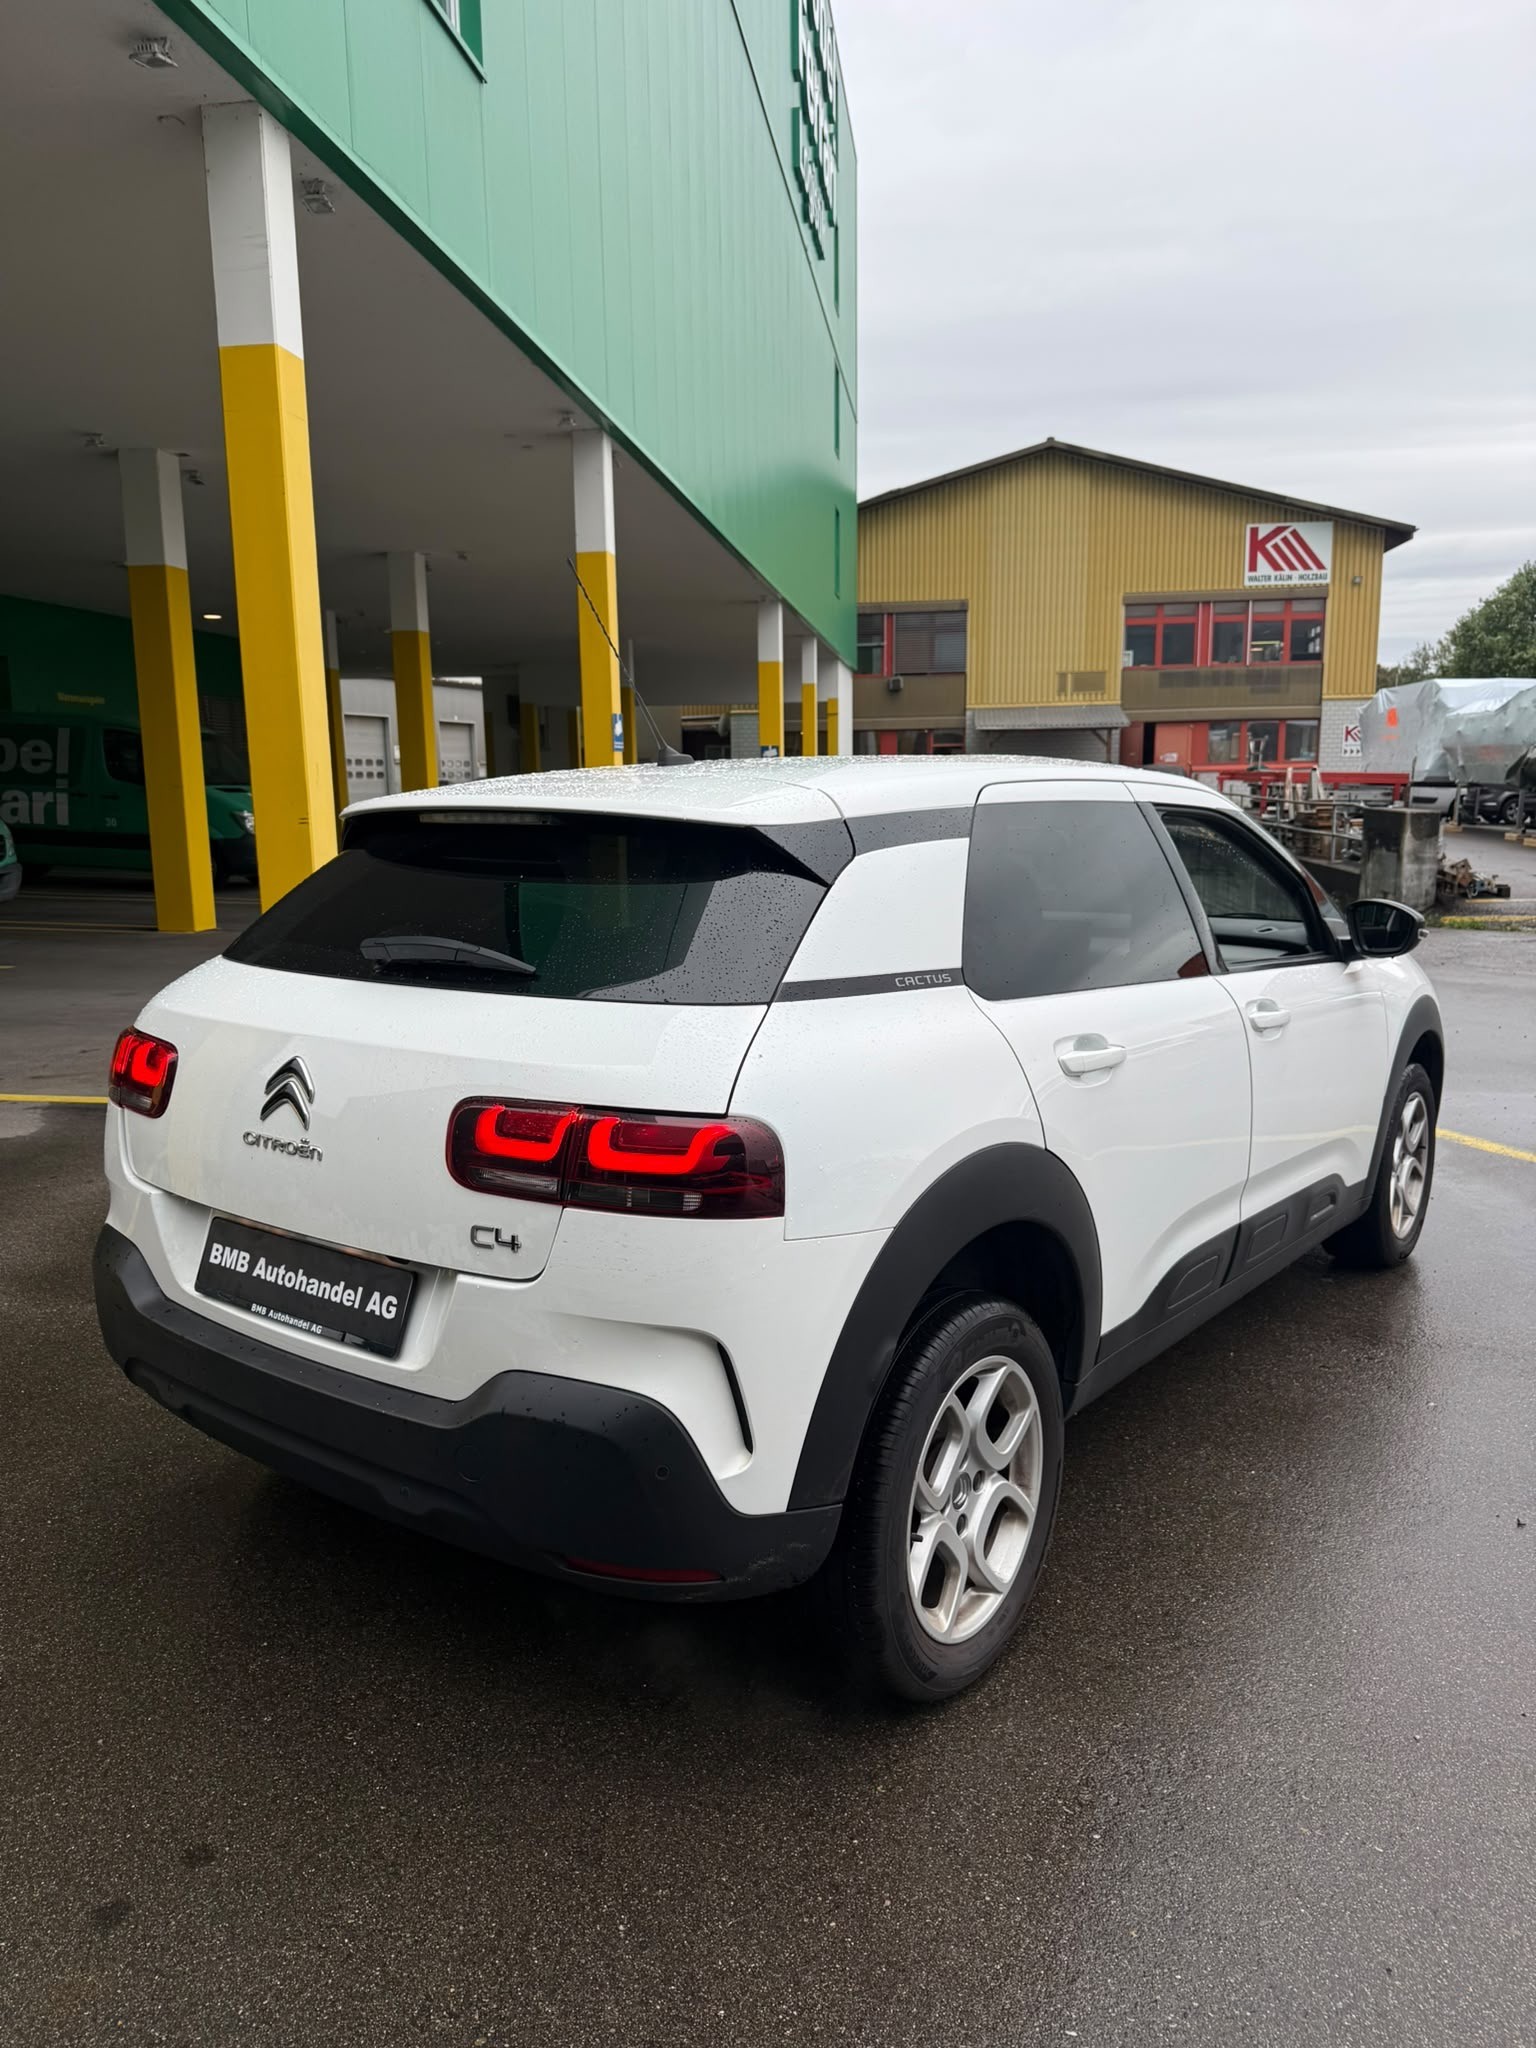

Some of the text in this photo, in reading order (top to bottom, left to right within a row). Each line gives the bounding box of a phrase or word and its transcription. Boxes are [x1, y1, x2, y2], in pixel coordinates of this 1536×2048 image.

[1247, 574, 1272, 583] WALTER
[1297, 572, 1328, 581] HOLZBAU
[895, 973, 952, 987] CACTUS
[470, 1224, 522, 1253] C4
[209, 1242, 399, 1320] BMB Autohandel AG
[251, 1303, 323, 1335] BMB Autohandel AG
